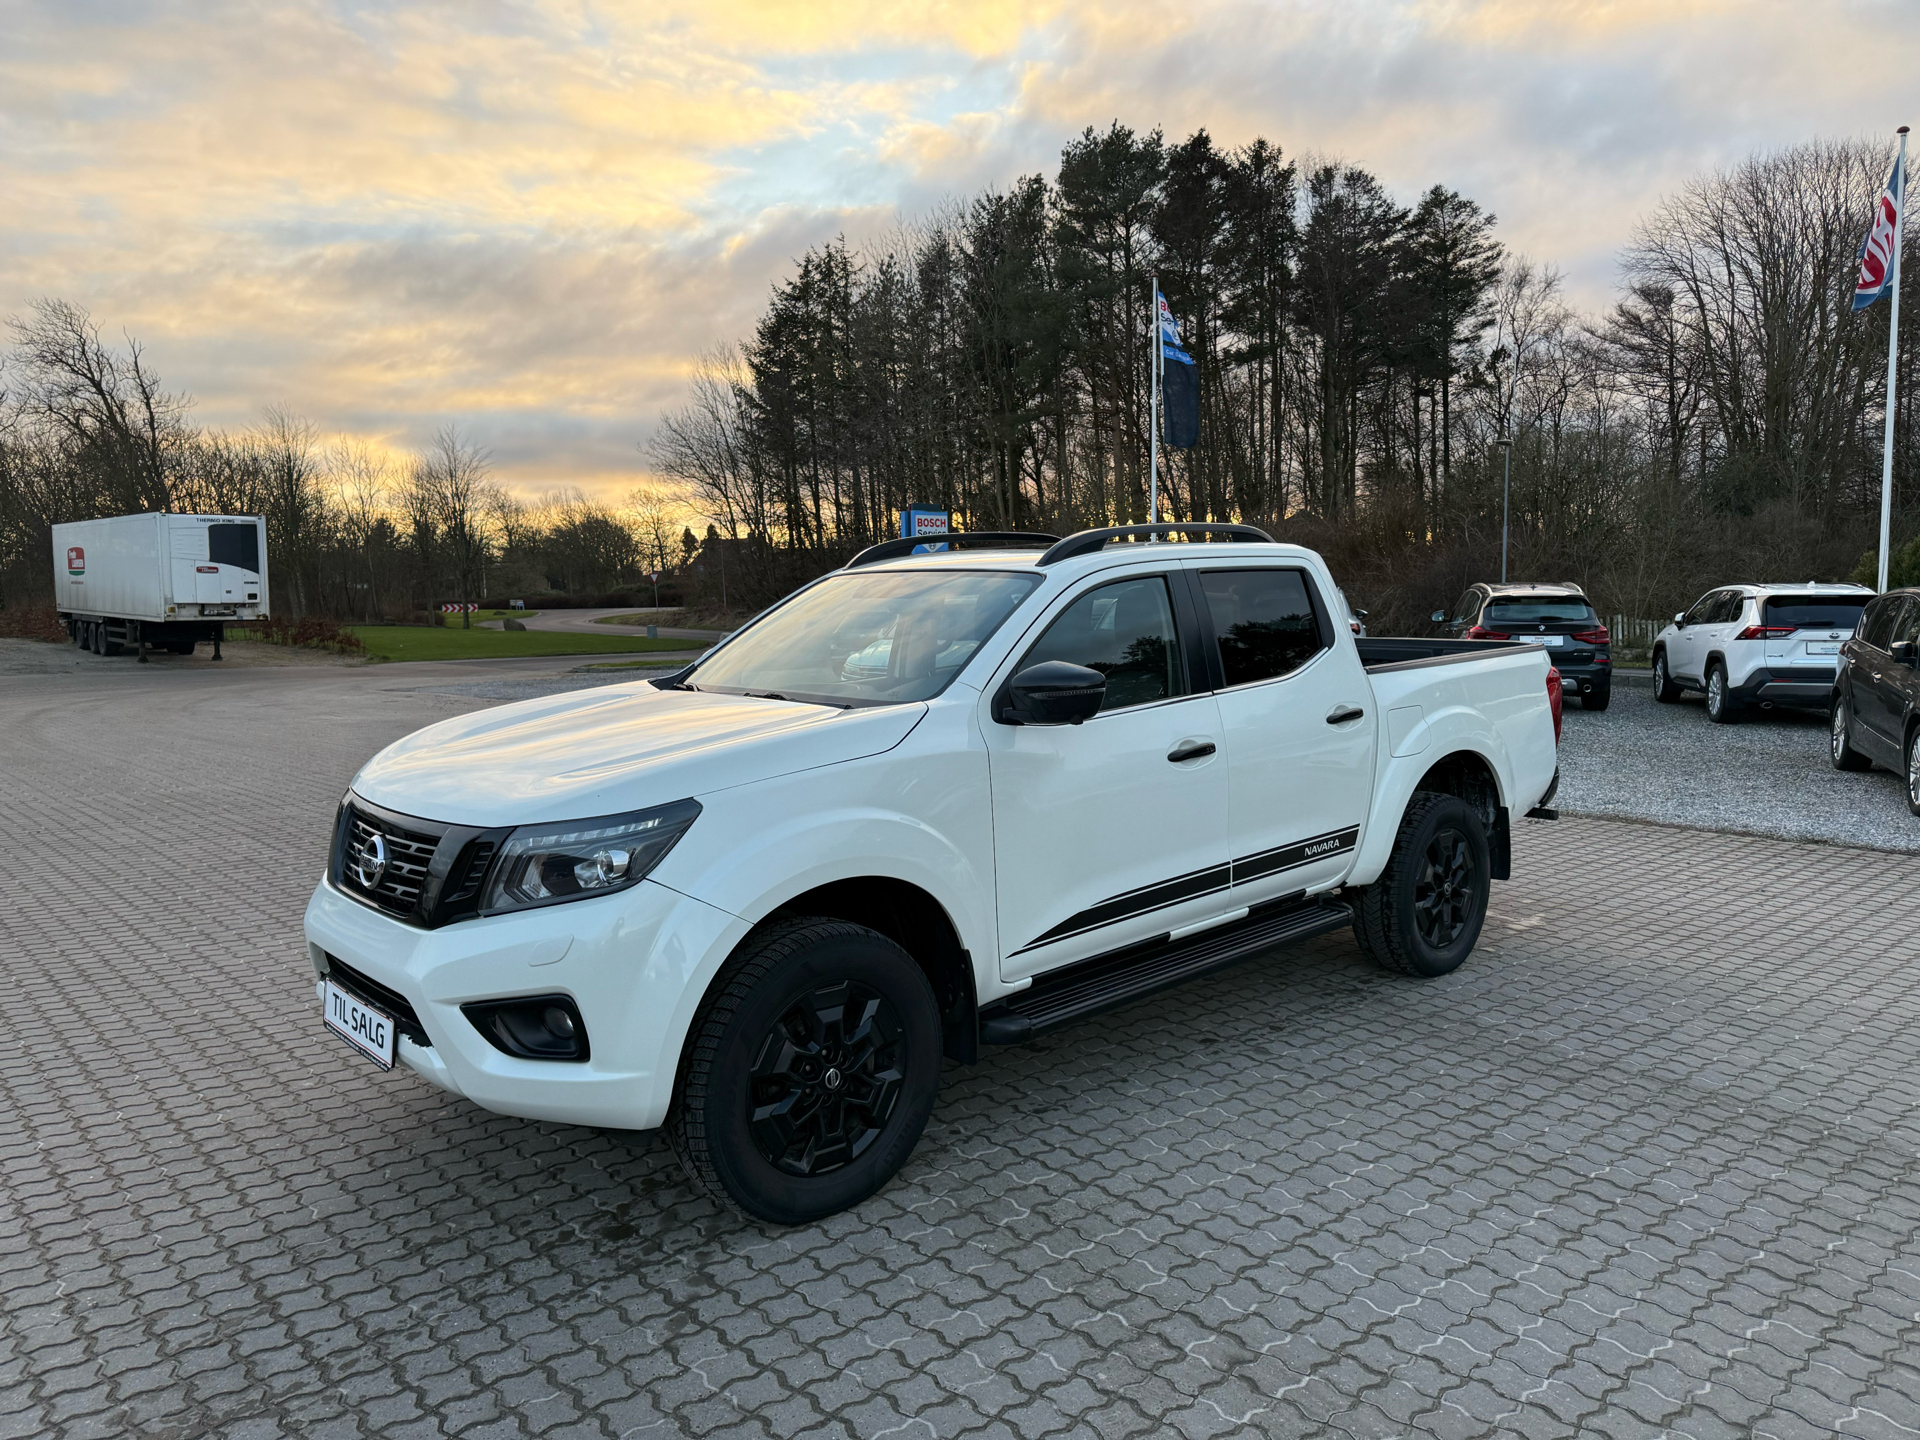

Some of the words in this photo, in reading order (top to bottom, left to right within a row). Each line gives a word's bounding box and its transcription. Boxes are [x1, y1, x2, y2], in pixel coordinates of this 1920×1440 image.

[917, 517, 946, 528] BOSCH
[1304, 838, 1340, 857] NAVARA
[332, 991, 349, 1026] TIL
[351, 1006, 385, 1049] SALG
